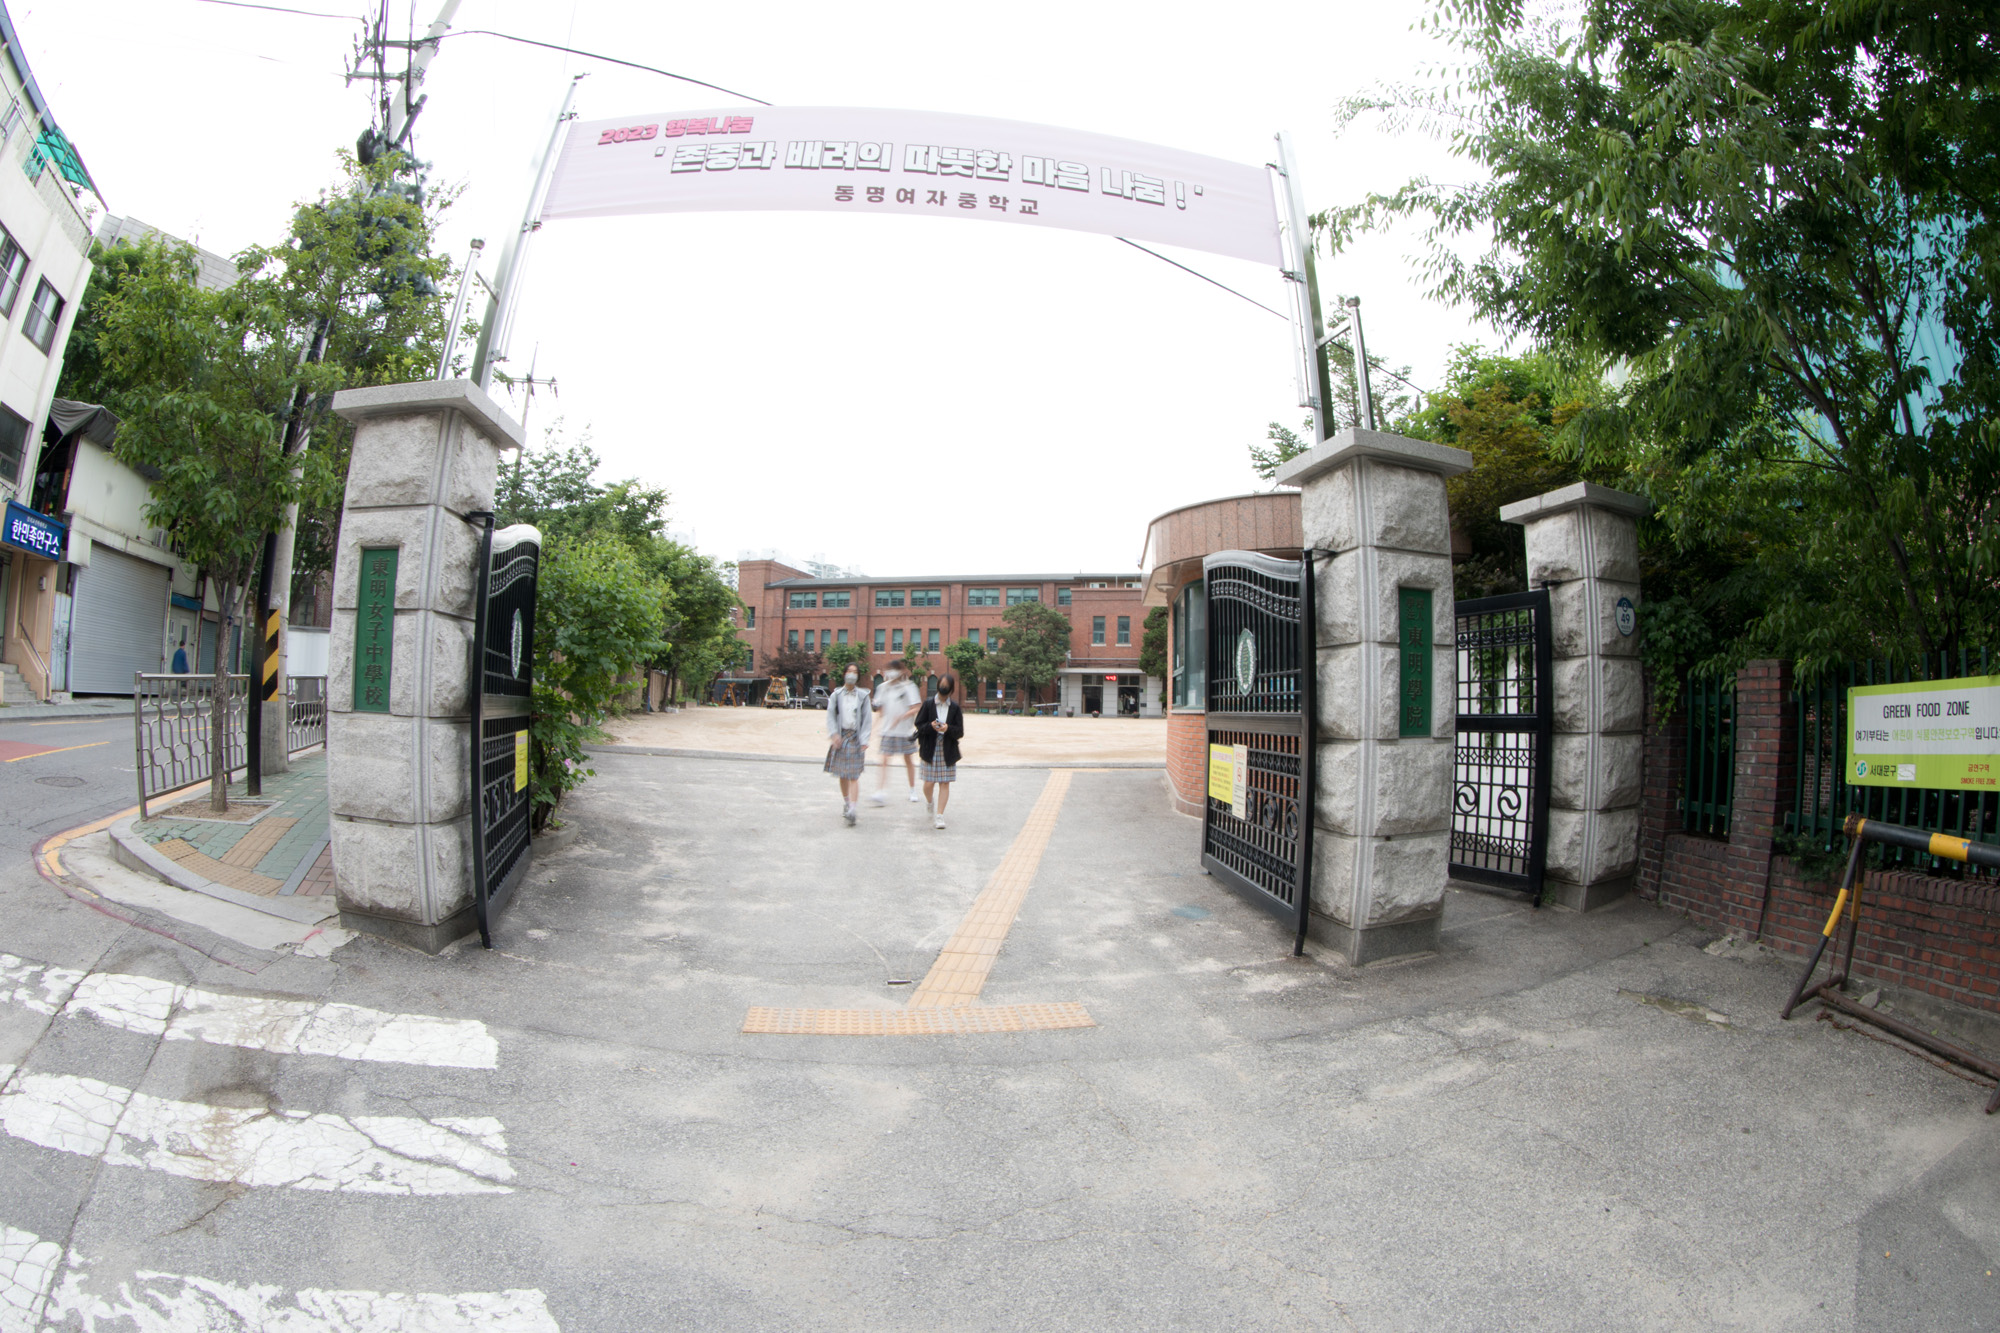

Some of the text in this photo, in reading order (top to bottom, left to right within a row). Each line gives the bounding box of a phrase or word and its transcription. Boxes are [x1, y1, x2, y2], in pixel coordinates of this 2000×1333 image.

[598, 116, 754, 145] 2023 행복나눔
[784, 140, 893, 170] 배려의
[903, 144, 1013, 181] 따뜻한
[1022, 155, 1089, 193] 마음
[12, 519, 59, 555] 한민족연구소
[1621, 613, 1630, 624] 49
[364, 556, 390, 706] 東明女子中學校
[1882, 700, 1970, 719] GREEN FOOD ZONE
[1855, 726, 2000, 741] 여기부터는 어린이 식품안전보호구역입니다
[1870, 764, 1897, 777] 서대문구
